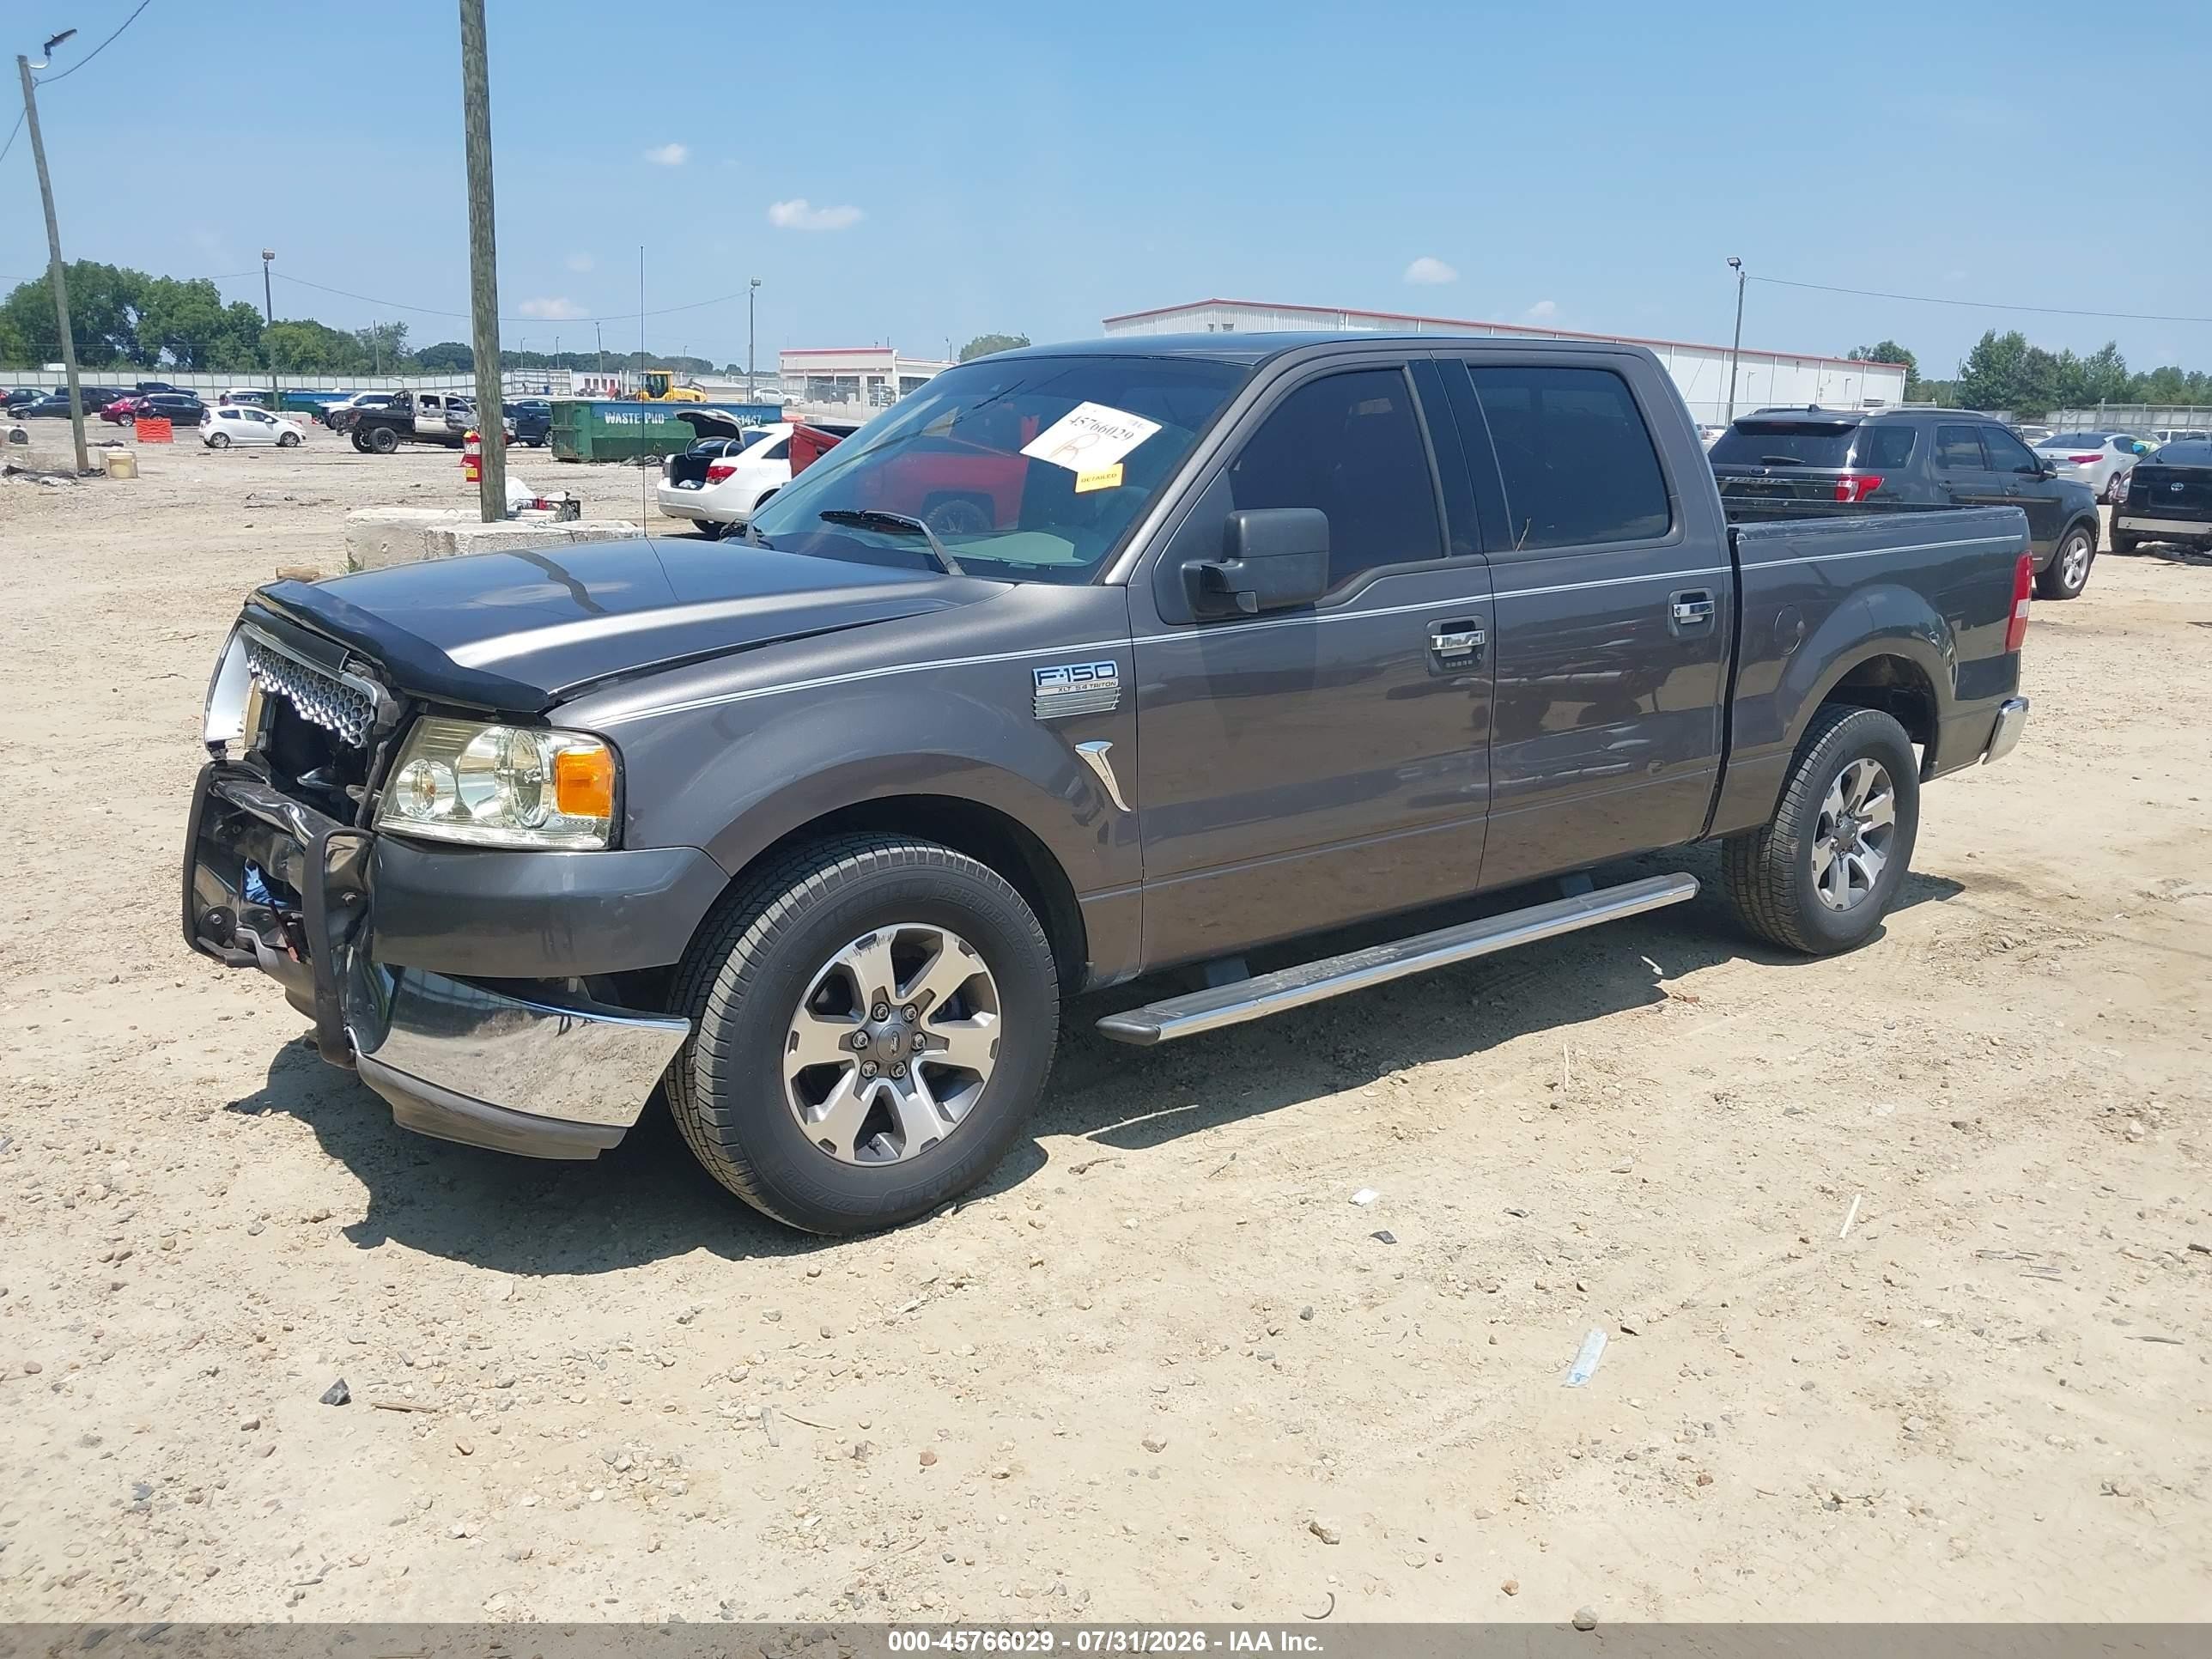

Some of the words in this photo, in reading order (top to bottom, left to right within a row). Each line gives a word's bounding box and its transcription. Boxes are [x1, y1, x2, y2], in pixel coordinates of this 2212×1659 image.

[604, 412, 641, 424] WASTE
[1069, 416, 1134, 441] 45766029
[1080, 472, 1118, 483] DETAILED
[1089, 681, 1116, 690] TRITON
[939, 883, 1009, 928] DEFENDER
